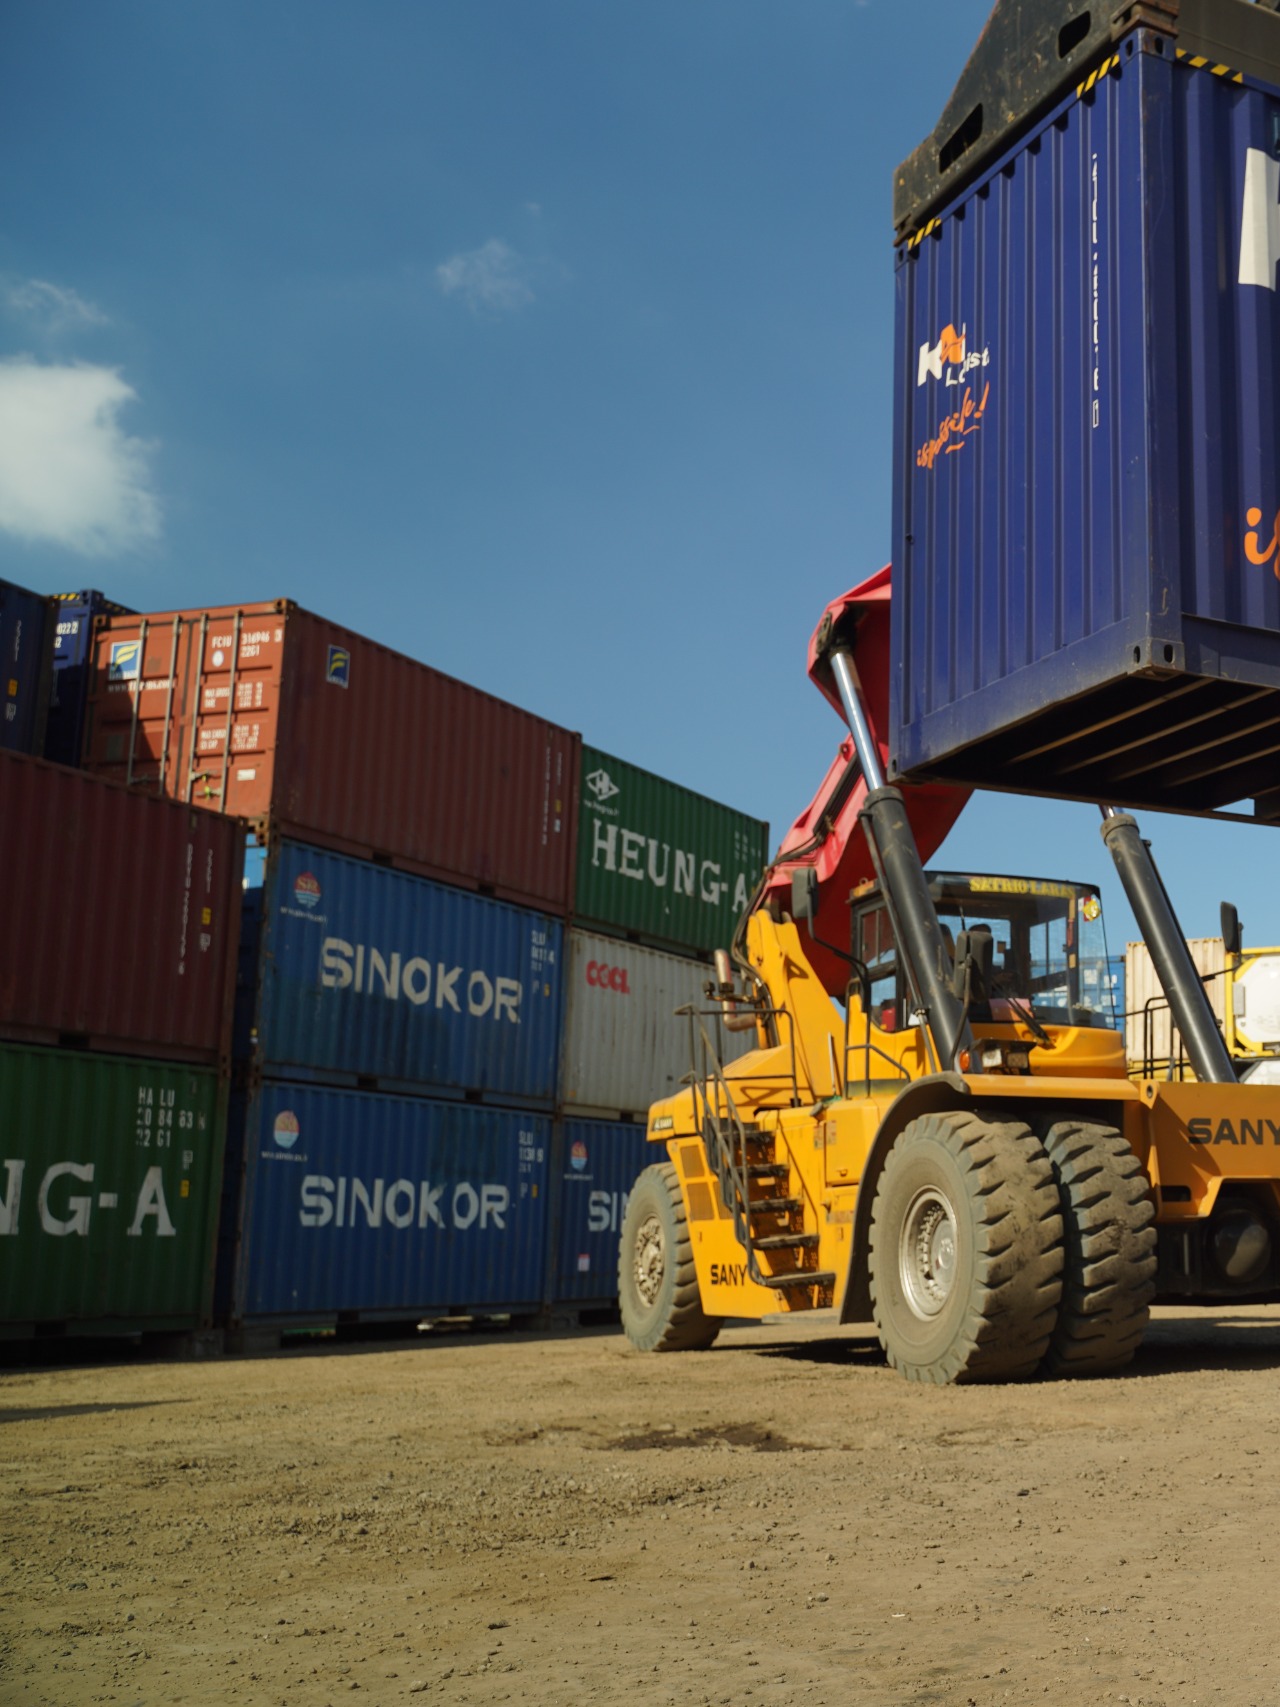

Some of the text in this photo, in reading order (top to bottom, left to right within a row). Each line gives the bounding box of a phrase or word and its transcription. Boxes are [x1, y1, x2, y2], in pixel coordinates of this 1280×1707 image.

[917, 322, 966, 387] KAI
[592, 817, 750, 914] HEUNG-A
[321, 936, 523, 1025] SINOKOR
[299, 1174, 510, 1230] SINOKOR
[711, 1264, 747, 1287] SANY
